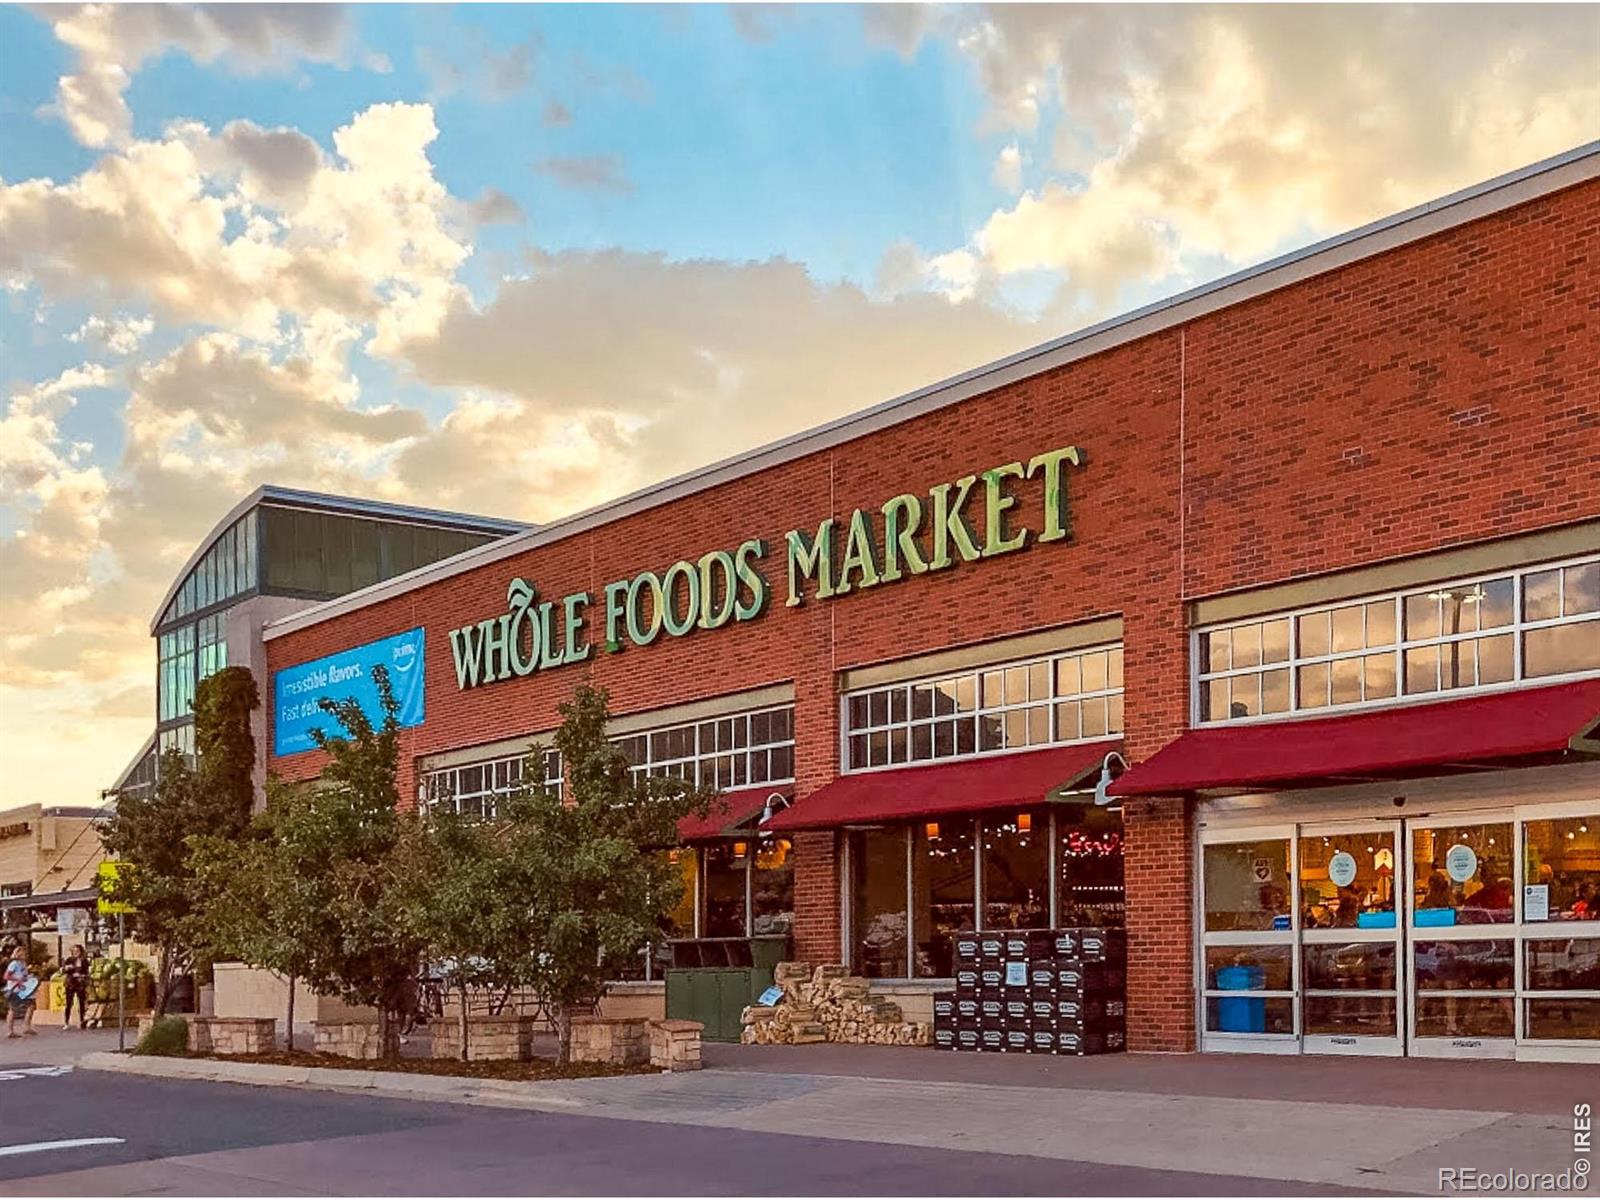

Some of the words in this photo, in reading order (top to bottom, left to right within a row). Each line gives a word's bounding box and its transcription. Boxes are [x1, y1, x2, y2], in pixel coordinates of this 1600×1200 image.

[449, 578, 591, 690] WHOLE
[605, 539, 766, 653] FOODS
[785, 445, 1080, 608] MARKET
